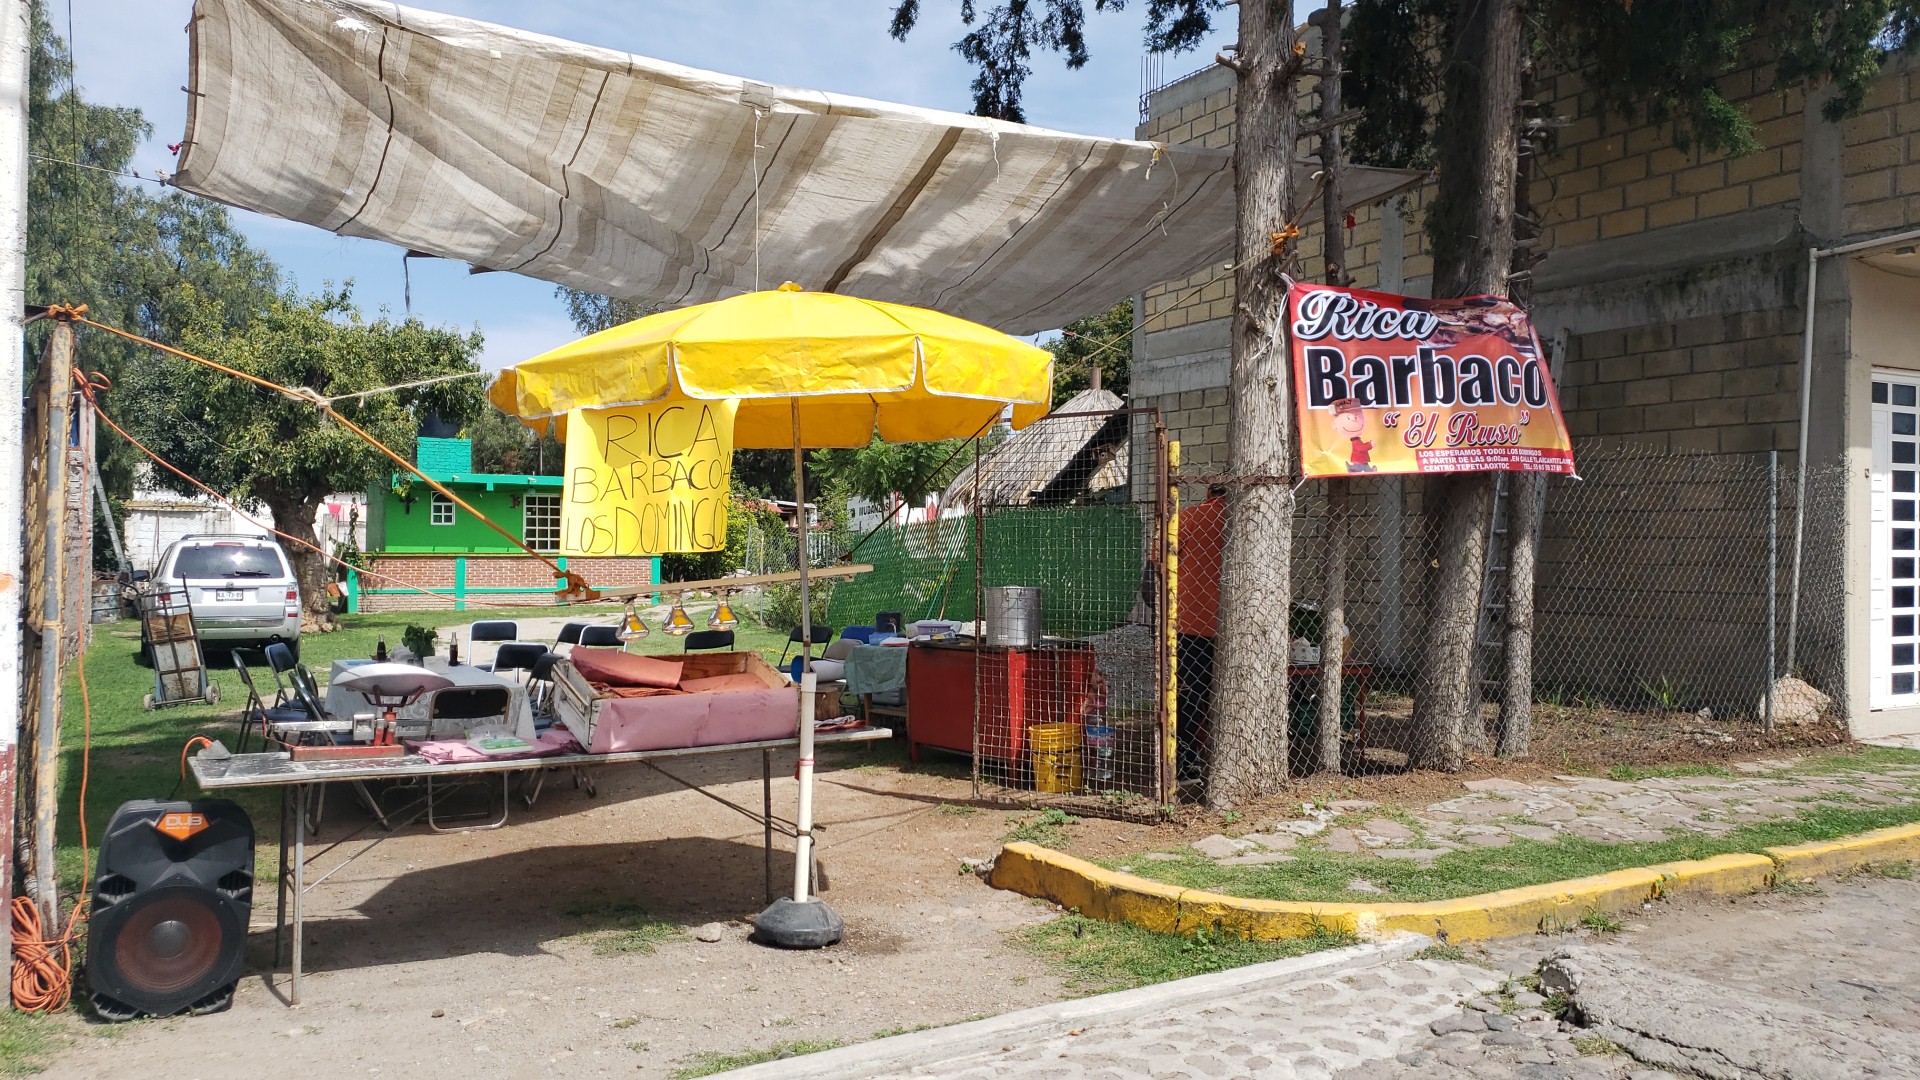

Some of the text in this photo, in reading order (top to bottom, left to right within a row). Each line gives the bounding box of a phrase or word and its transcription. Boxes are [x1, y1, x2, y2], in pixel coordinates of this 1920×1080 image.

[1293, 290, 1440, 341] Rica
[604, 404, 721, 464] RICA
[1418, 450, 1434, 458] LOS
[1435, 449, 1481, 458] ESPERAMOS
[1483, 448, 1506, 456] TODOS
[1507, 448, 1519, 456] LOS
[1429, 456, 1457, 464] PARTIR
[1458, 456, 1469, 464] DE
[571, 451, 731, 504] BARBACOA
[1424, 464, 1455, 472] CENTRO
[1456, 463, 1510, 472] TEPETLAOXTOC
[565, 515, 614, 554] LOS
[165, 816, 203, 826] DUB
